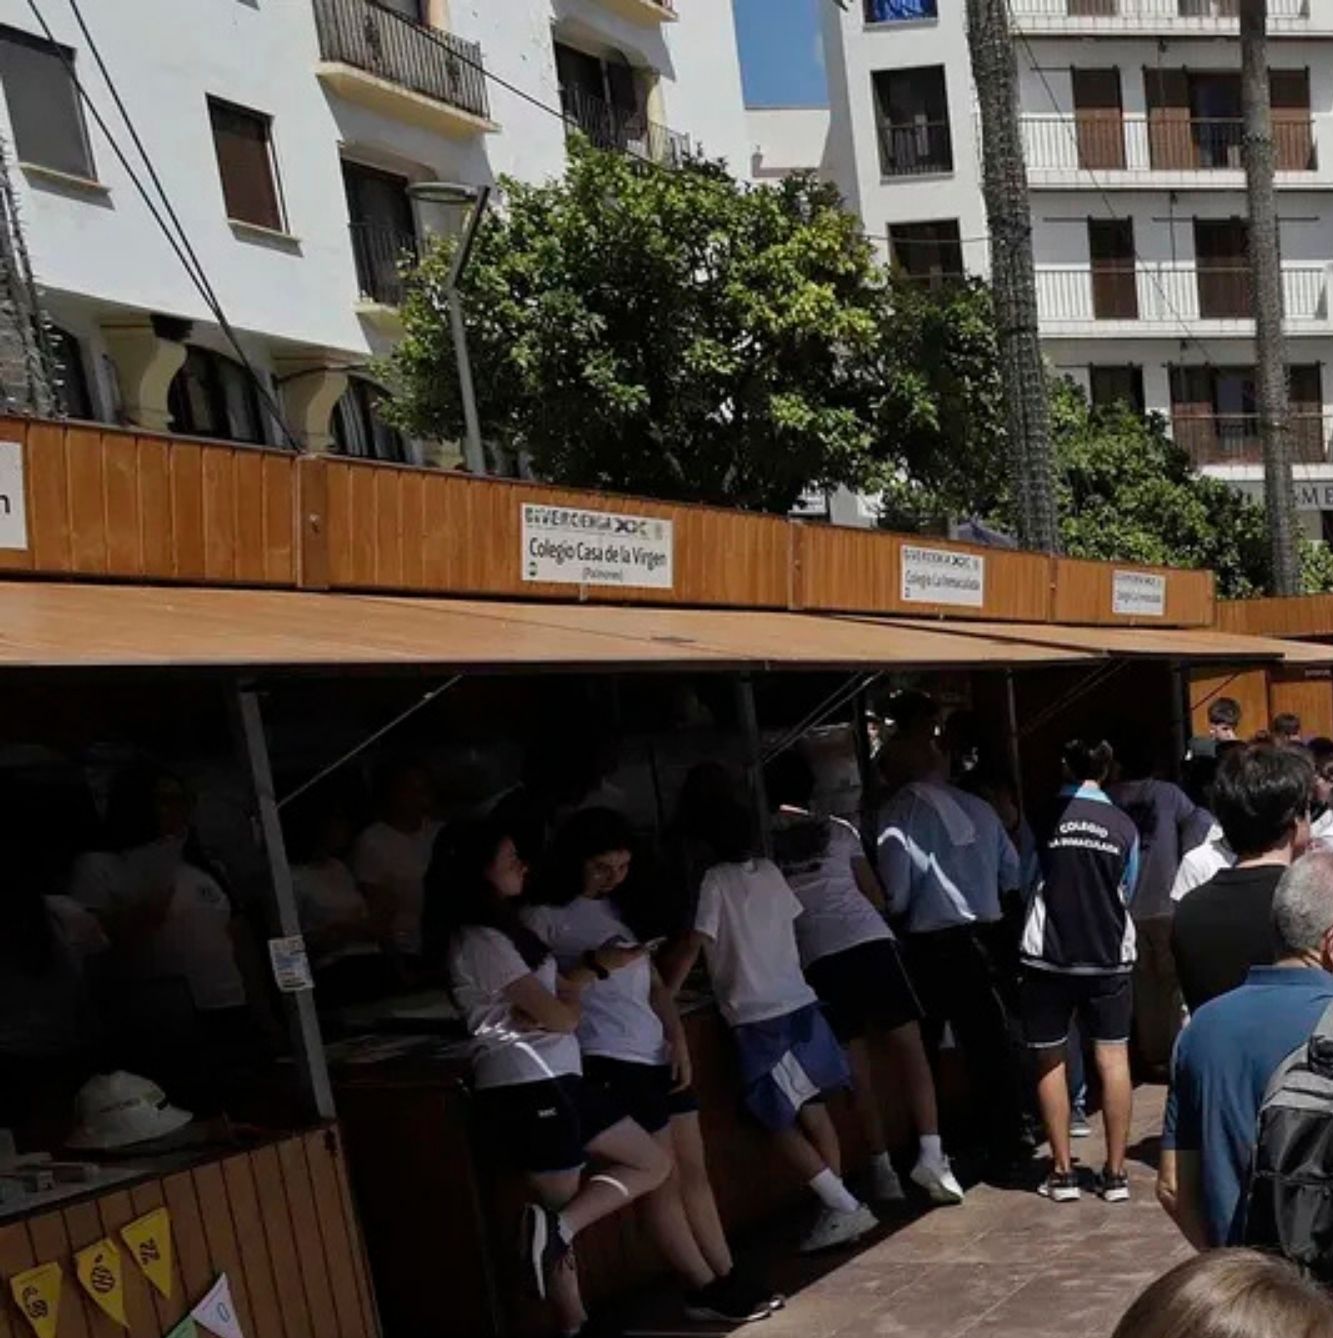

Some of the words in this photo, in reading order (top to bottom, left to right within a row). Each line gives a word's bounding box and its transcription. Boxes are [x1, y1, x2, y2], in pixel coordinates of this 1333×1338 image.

[529, 536, 574, 566] Colegio
[576, 541, 603, 562] Casa
[605, 545, 619, 564] de
[621, 547, 631, 564] la
[632, 546, 666, 572] Virgen
[1059, 821, 1109, 838] COLEGIO
